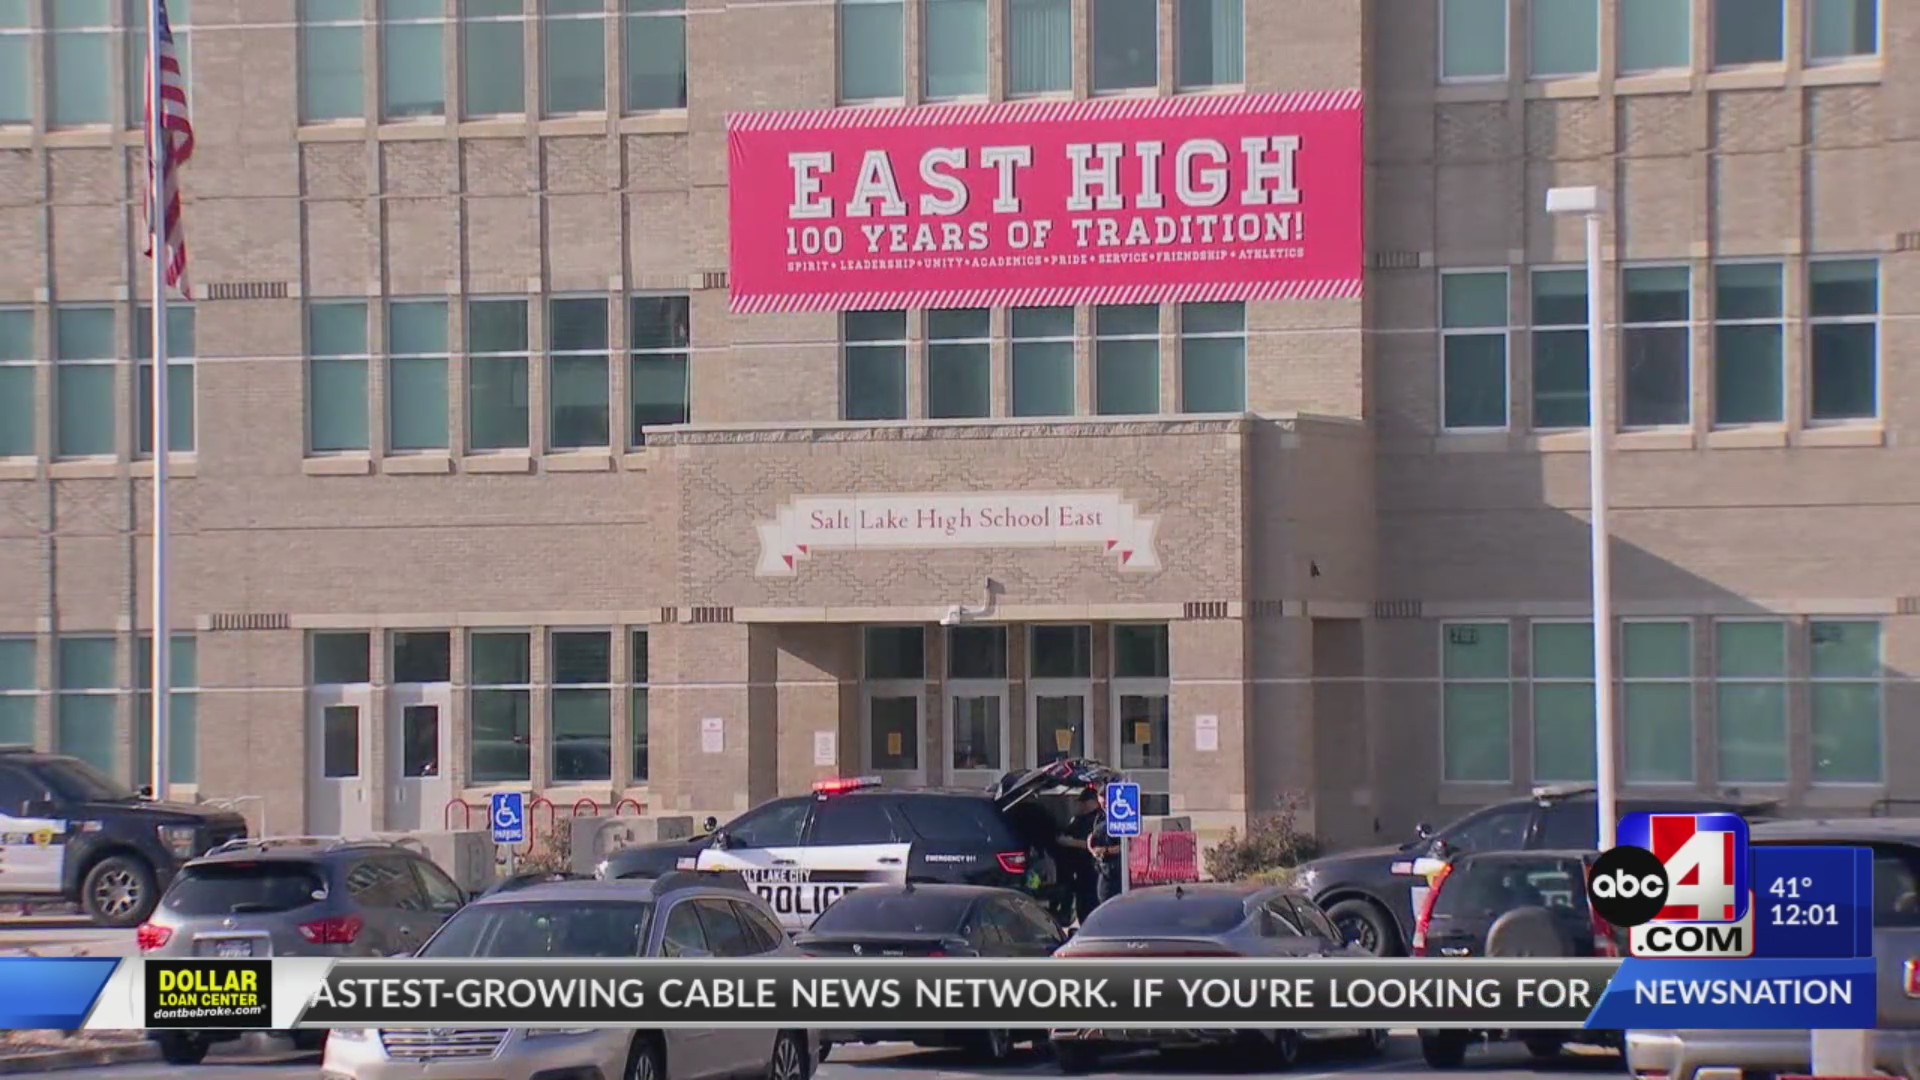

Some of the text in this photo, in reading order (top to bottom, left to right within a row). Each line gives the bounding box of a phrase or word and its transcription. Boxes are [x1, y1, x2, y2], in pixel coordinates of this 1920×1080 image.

[789, 135, 1303, 218] EAST HIGH
[787, 211, 1305, 255] 100 YEARS OF TRADITION!
[787, 247, 1304, 272] SPIRIT LEADERSHIP UNITY ACADEMICS PRIDE SERVICE FRIENDSHIP ATHLETICS
[811, 506, 1103, 536] Salt Lake High School East
[761, 869, 788, 882] LAKE
[790, 869, 811, 882] CITY
[757, 885, 859, 914] POLIC
